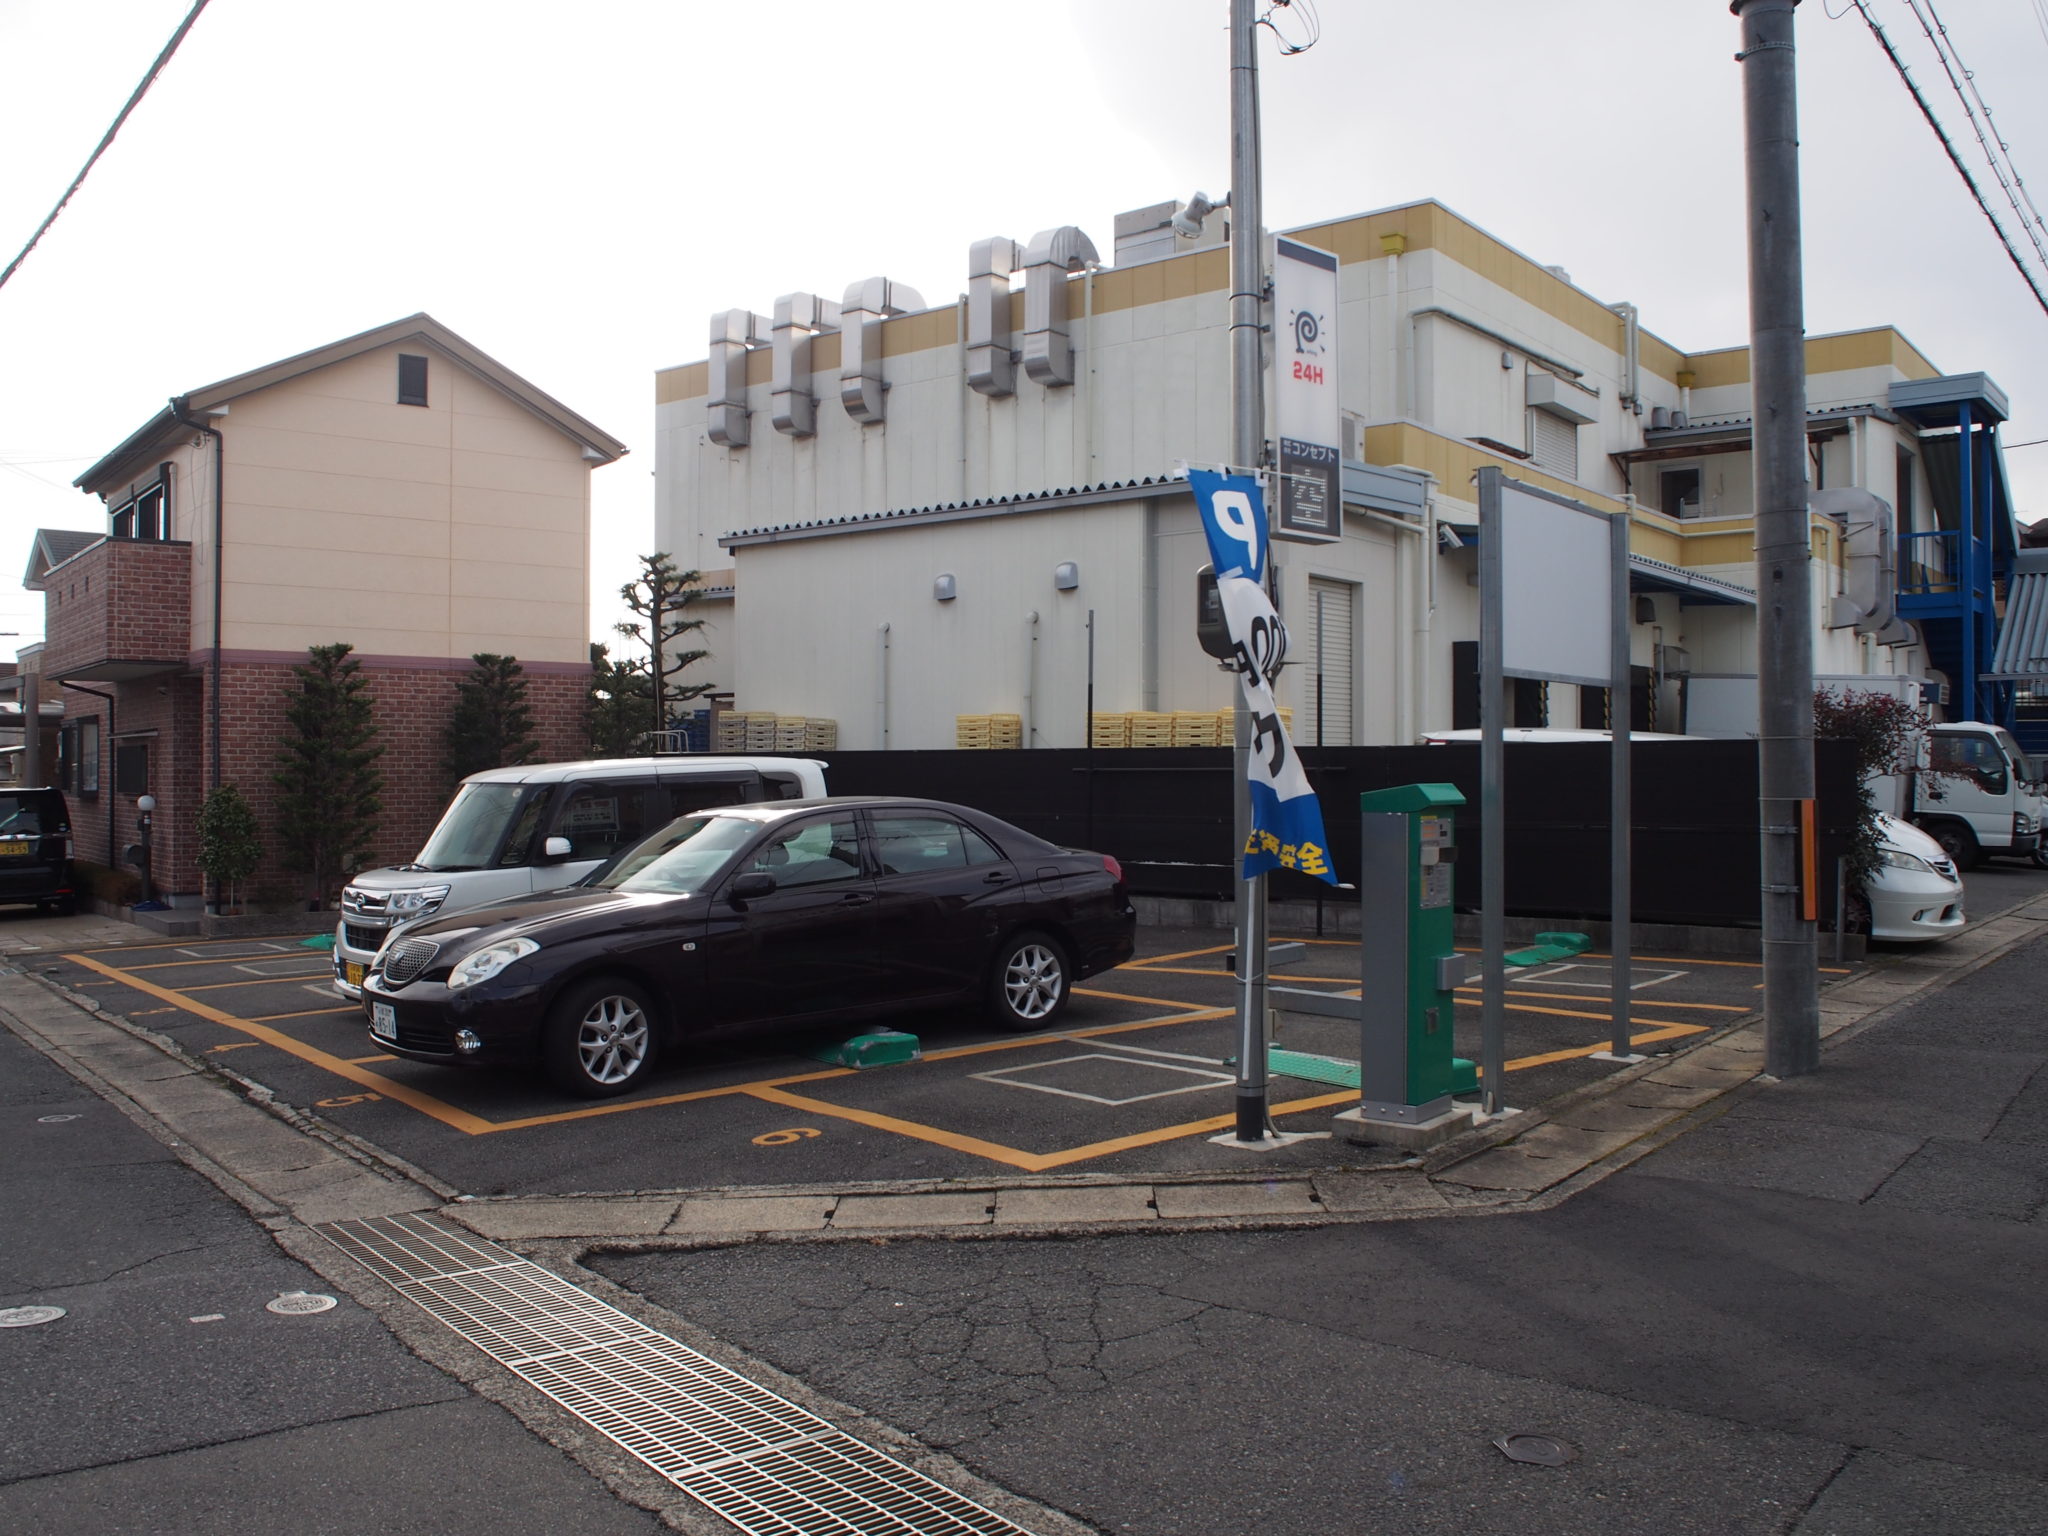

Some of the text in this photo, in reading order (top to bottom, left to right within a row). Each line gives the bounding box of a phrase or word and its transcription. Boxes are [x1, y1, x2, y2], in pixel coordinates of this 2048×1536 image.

[1293, 360, 1324, 385] 24H
[314, 1092, 383, 1108] 5
[751, 1127, 822, 1146] 6
